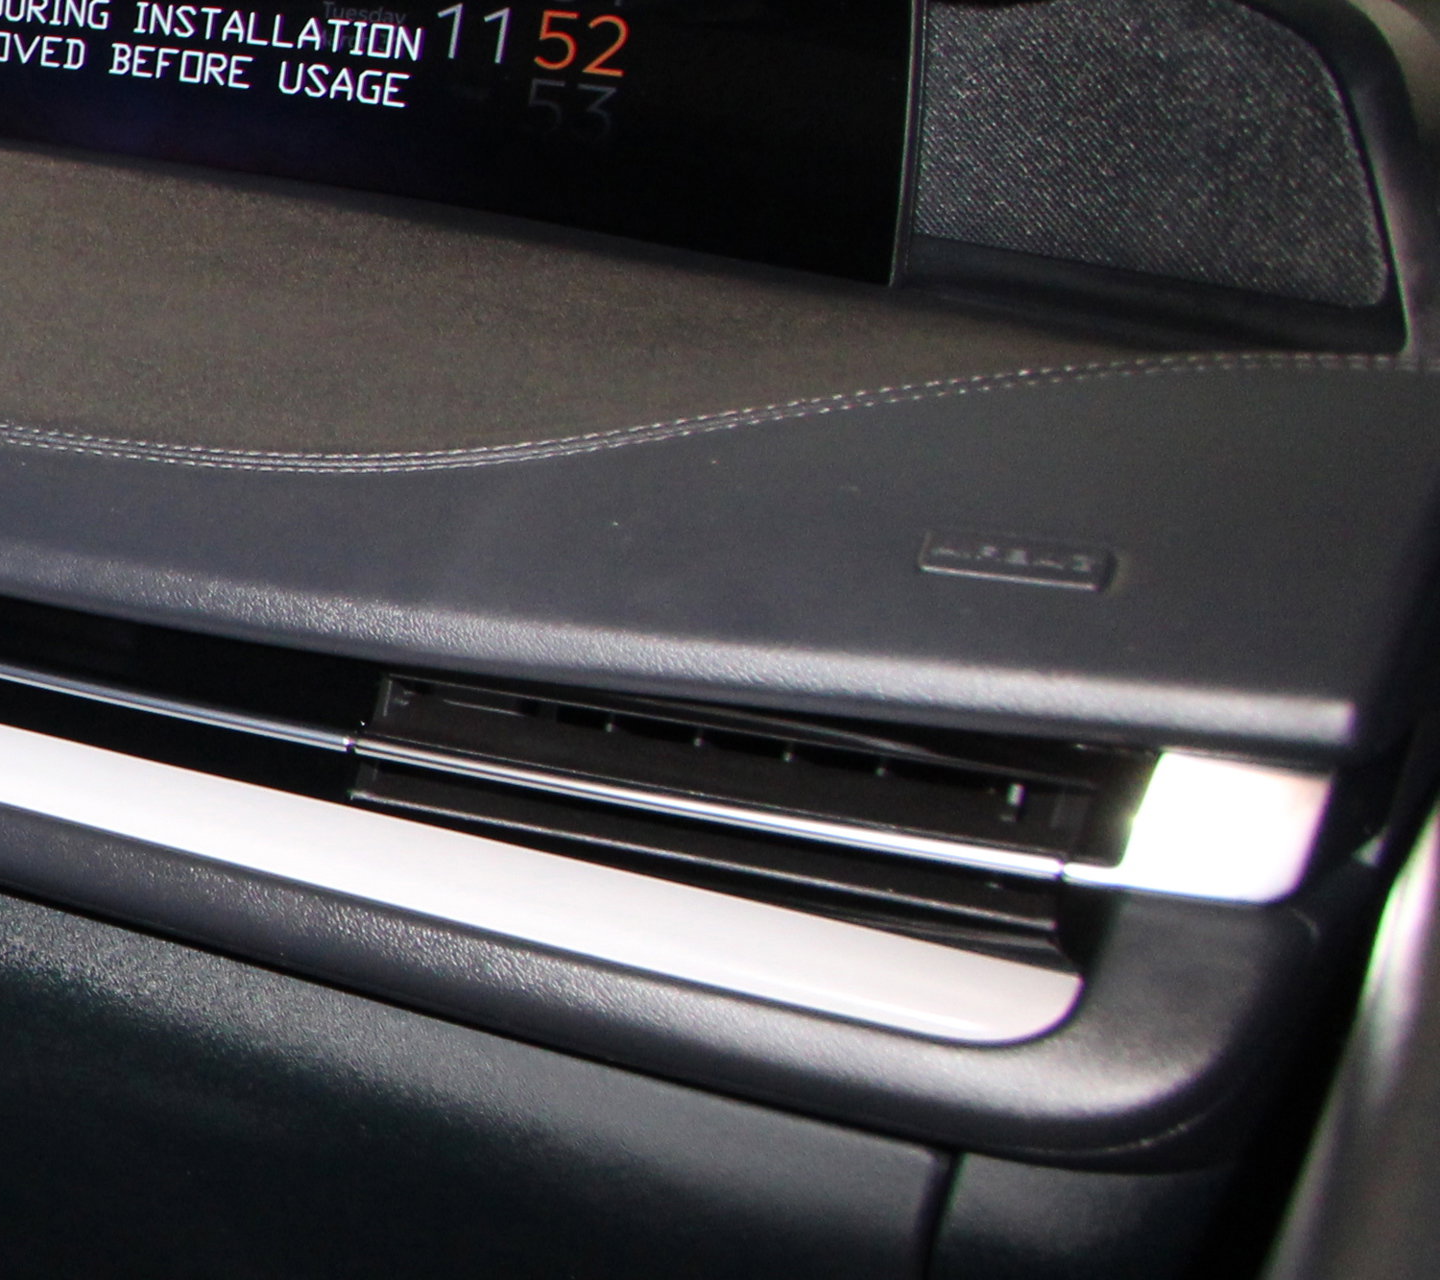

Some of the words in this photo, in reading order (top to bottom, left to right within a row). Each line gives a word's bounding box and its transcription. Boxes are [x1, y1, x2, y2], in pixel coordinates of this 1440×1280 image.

[133, 1, 424, 62] INSTALLATION
[436, 2, 512, 65] 11
[532, 8, 631, 79] 52
[108, 42, 254, 89] BEFORE
[278, 60, 411, 109] USAGE
